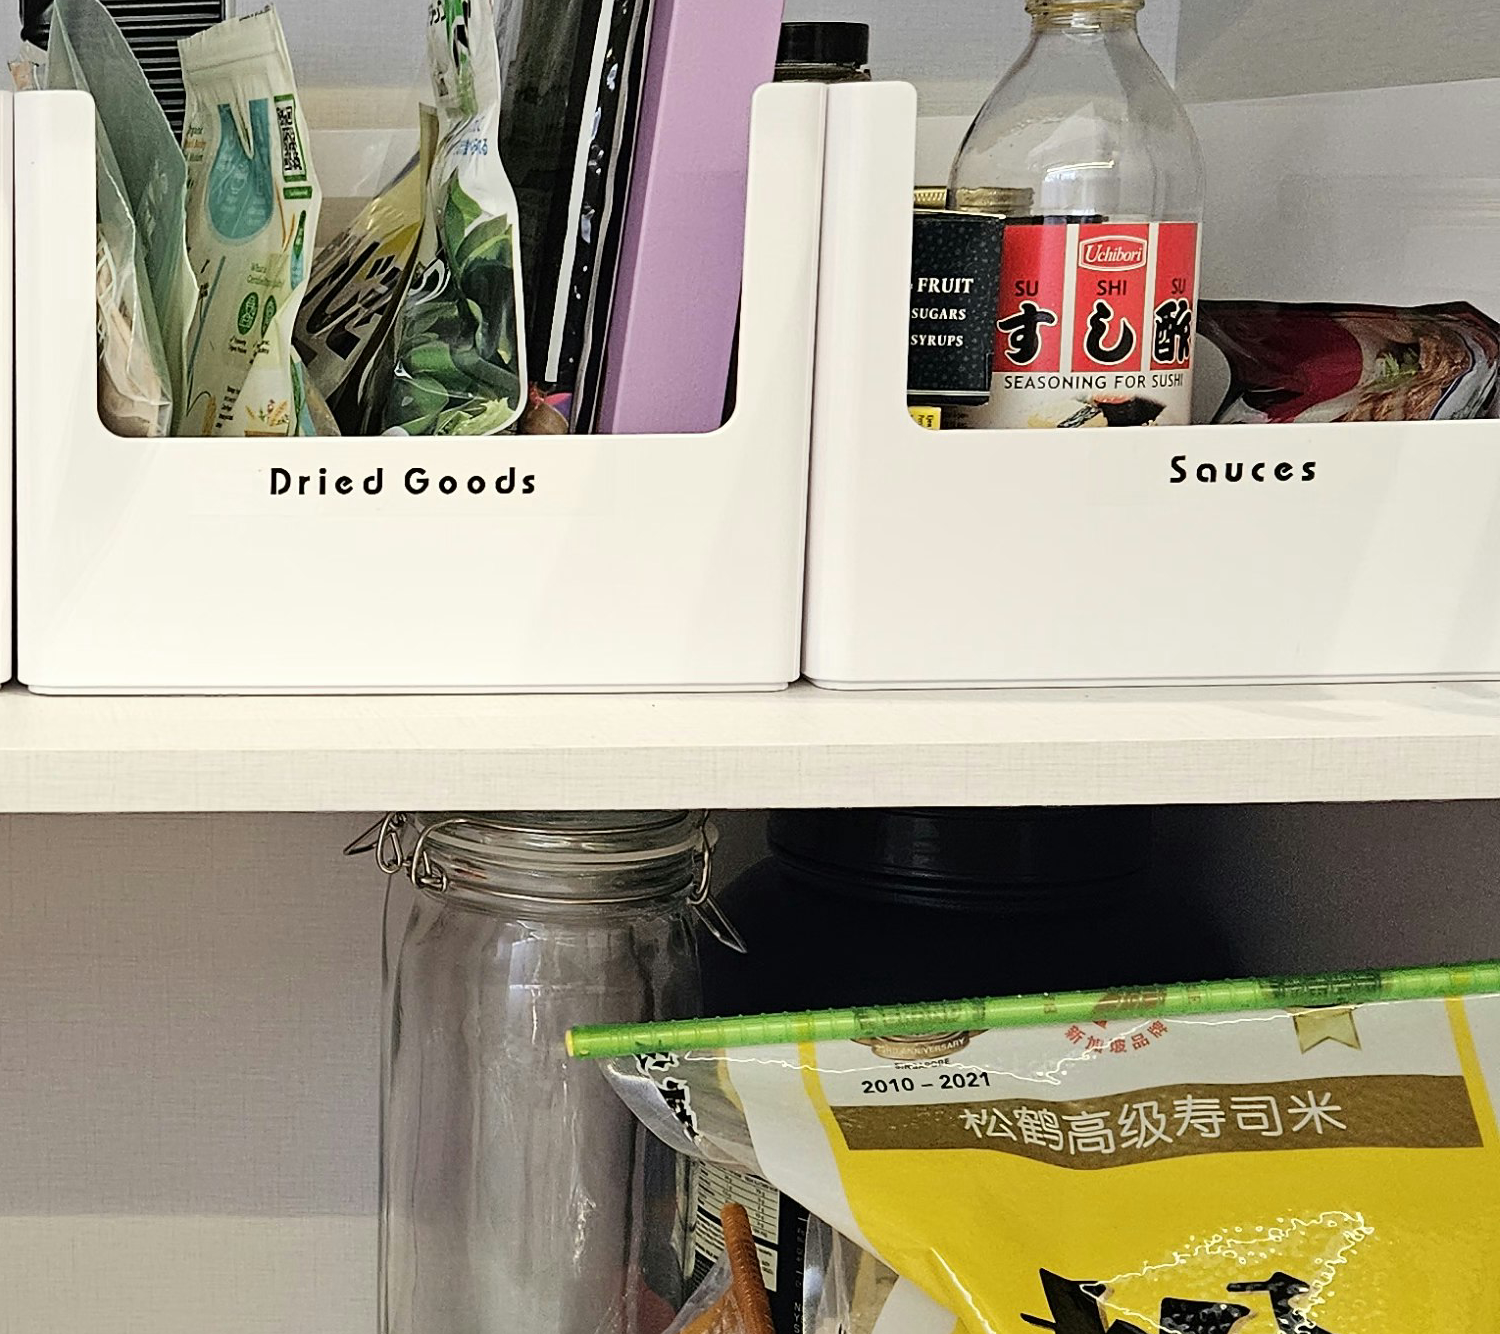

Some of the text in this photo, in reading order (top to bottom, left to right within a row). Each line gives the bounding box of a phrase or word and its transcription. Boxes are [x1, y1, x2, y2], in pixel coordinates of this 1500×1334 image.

[1083, 243, 1144, 264] Uchibori
[916, 277, 974, 295] FRUIT
[1014, 278, 1187, 297] SU SHI SU
[911, 307, 967, 322] SUGARS
[910, 334, 964, 348] SYRUPS
[1004, 373, 1184, 390] SEASONING FOR SUSHI
[1170, 455, 1318, 485] Sauces
[270, 467, 538, 497] Dried Goods
[1064, 1019, 1169, 1055] 新加坡品牌
[861, 1077, 915, 1094] 2010
[938, 1071, 991, 1090] 2021
[959, 1089, 1347, 1155] 松鹤高级寿司米
